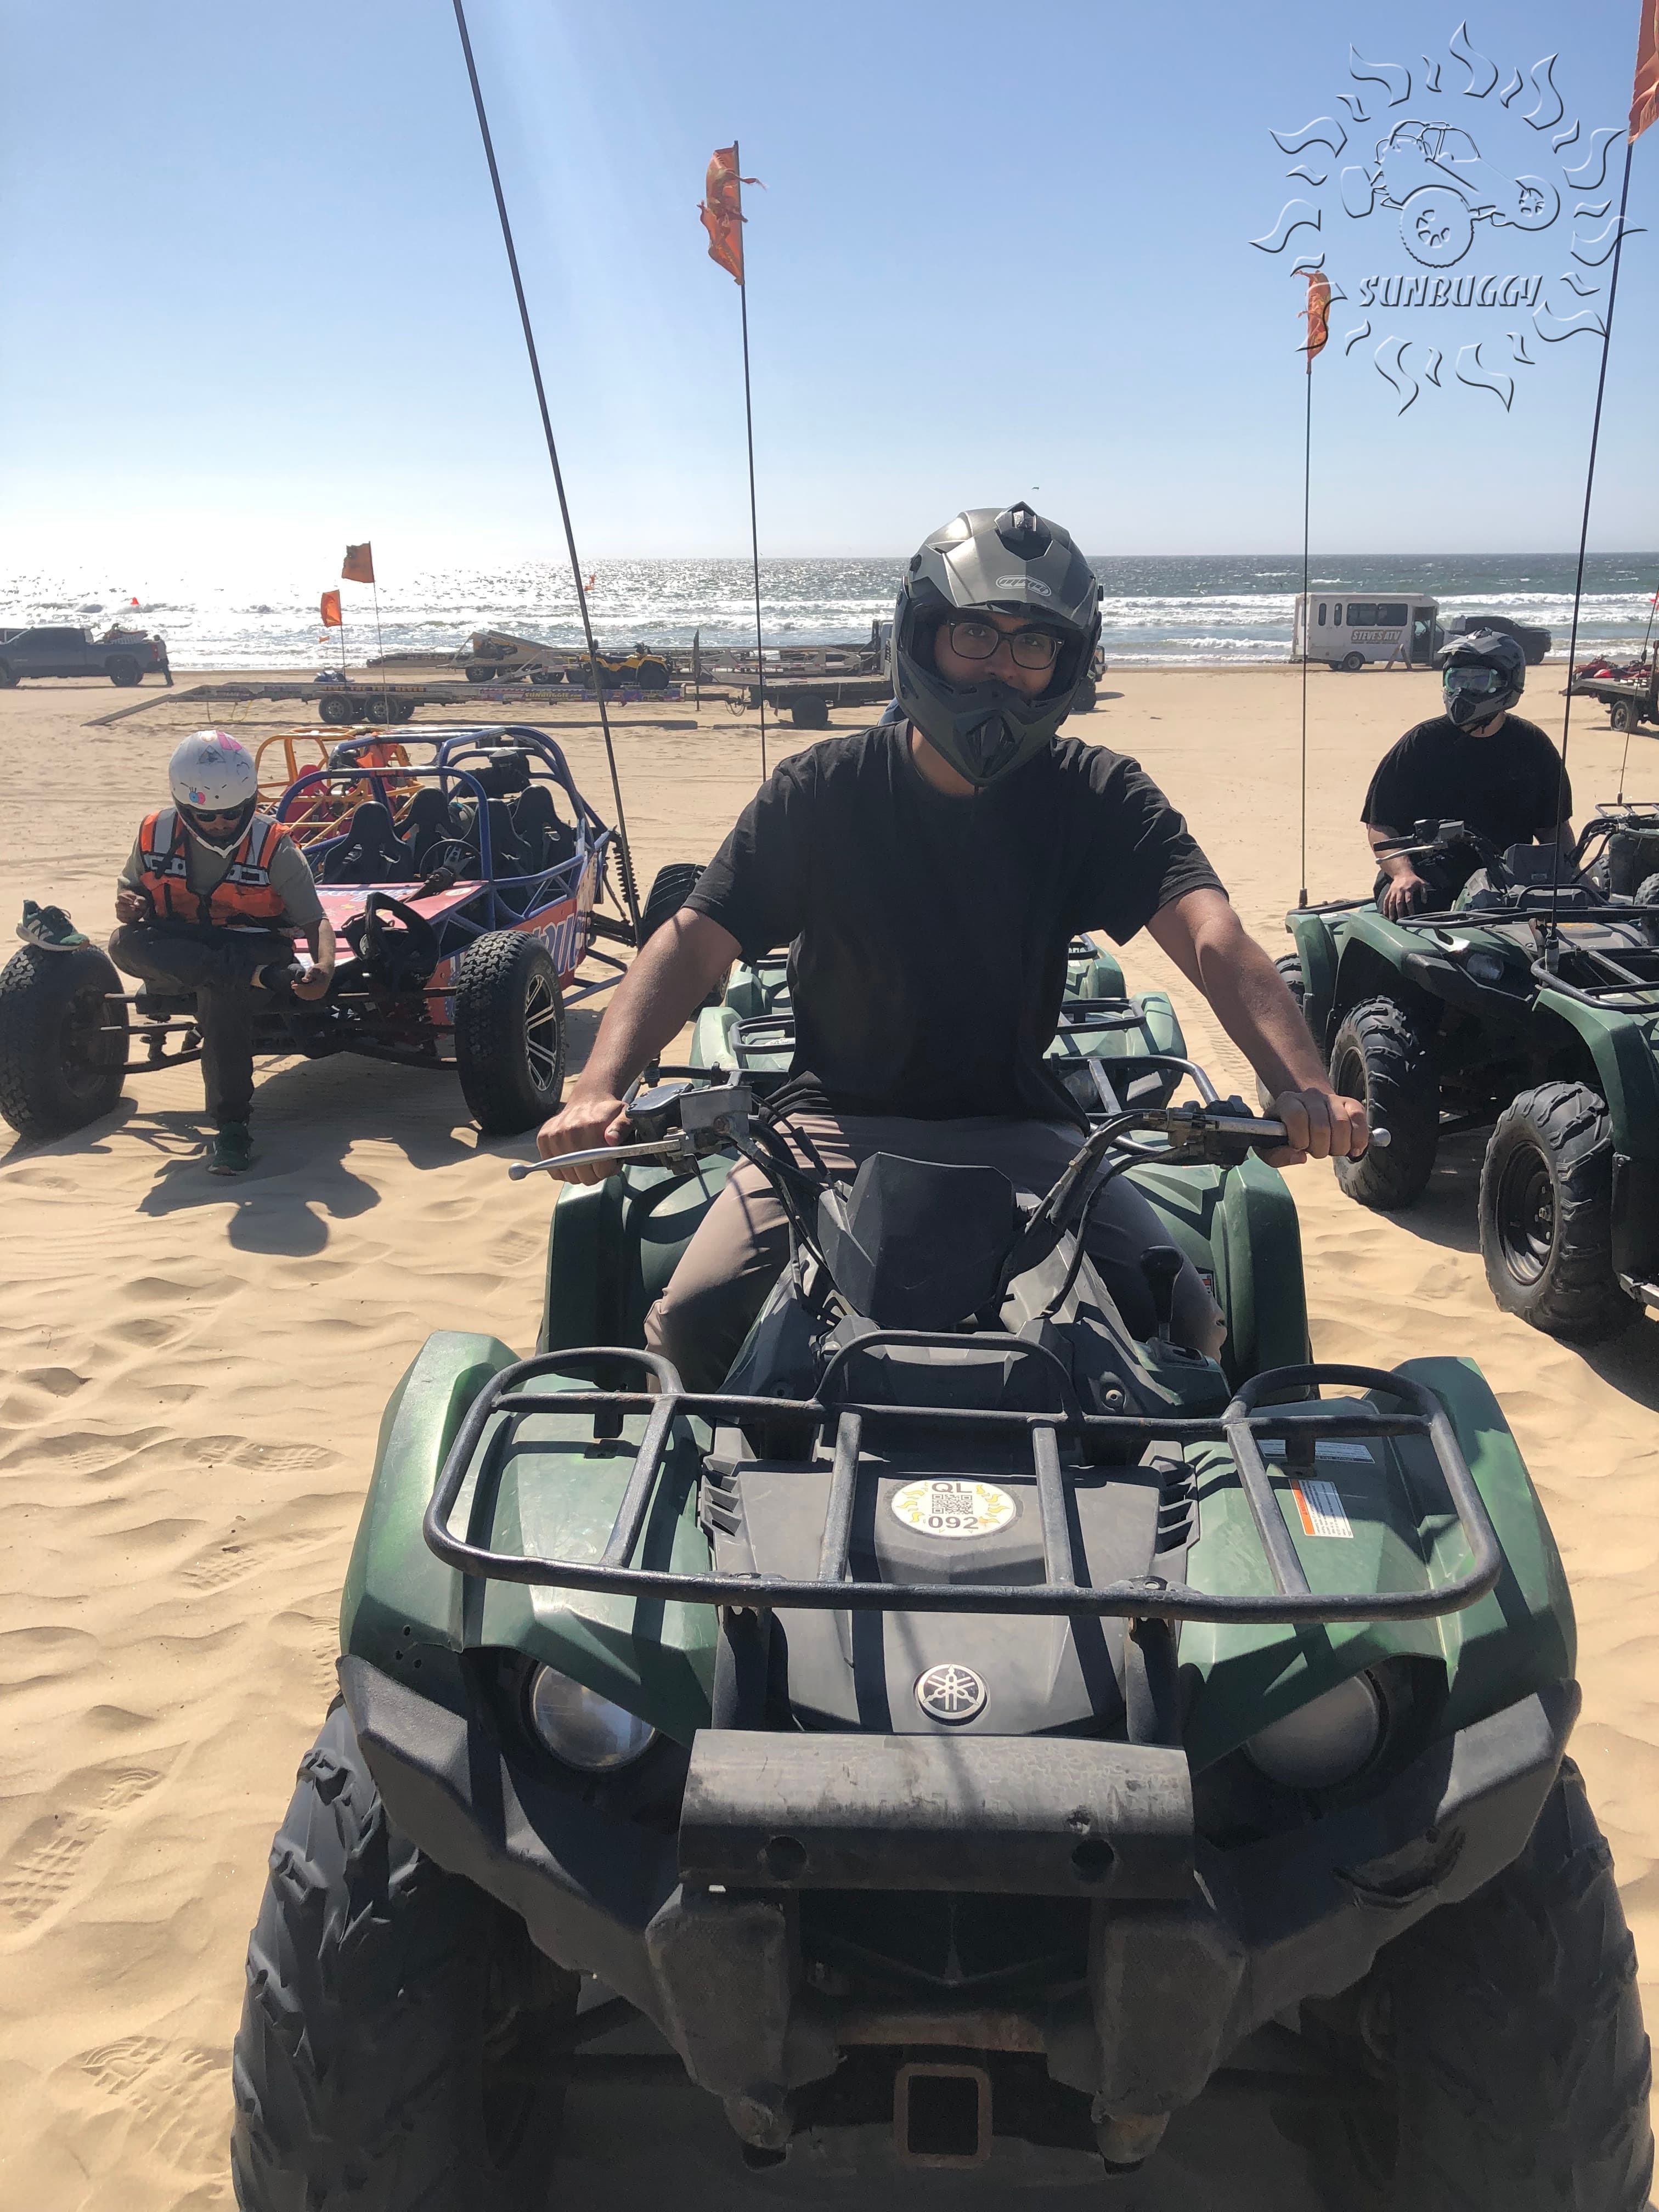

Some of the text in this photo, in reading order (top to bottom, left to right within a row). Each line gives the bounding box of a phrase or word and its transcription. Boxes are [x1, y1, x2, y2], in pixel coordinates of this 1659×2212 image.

[1384, 631, 1401, 640] ATV
[932, 1482, 972, 1493] QL
[928, 1516, 979, 1530] 092
